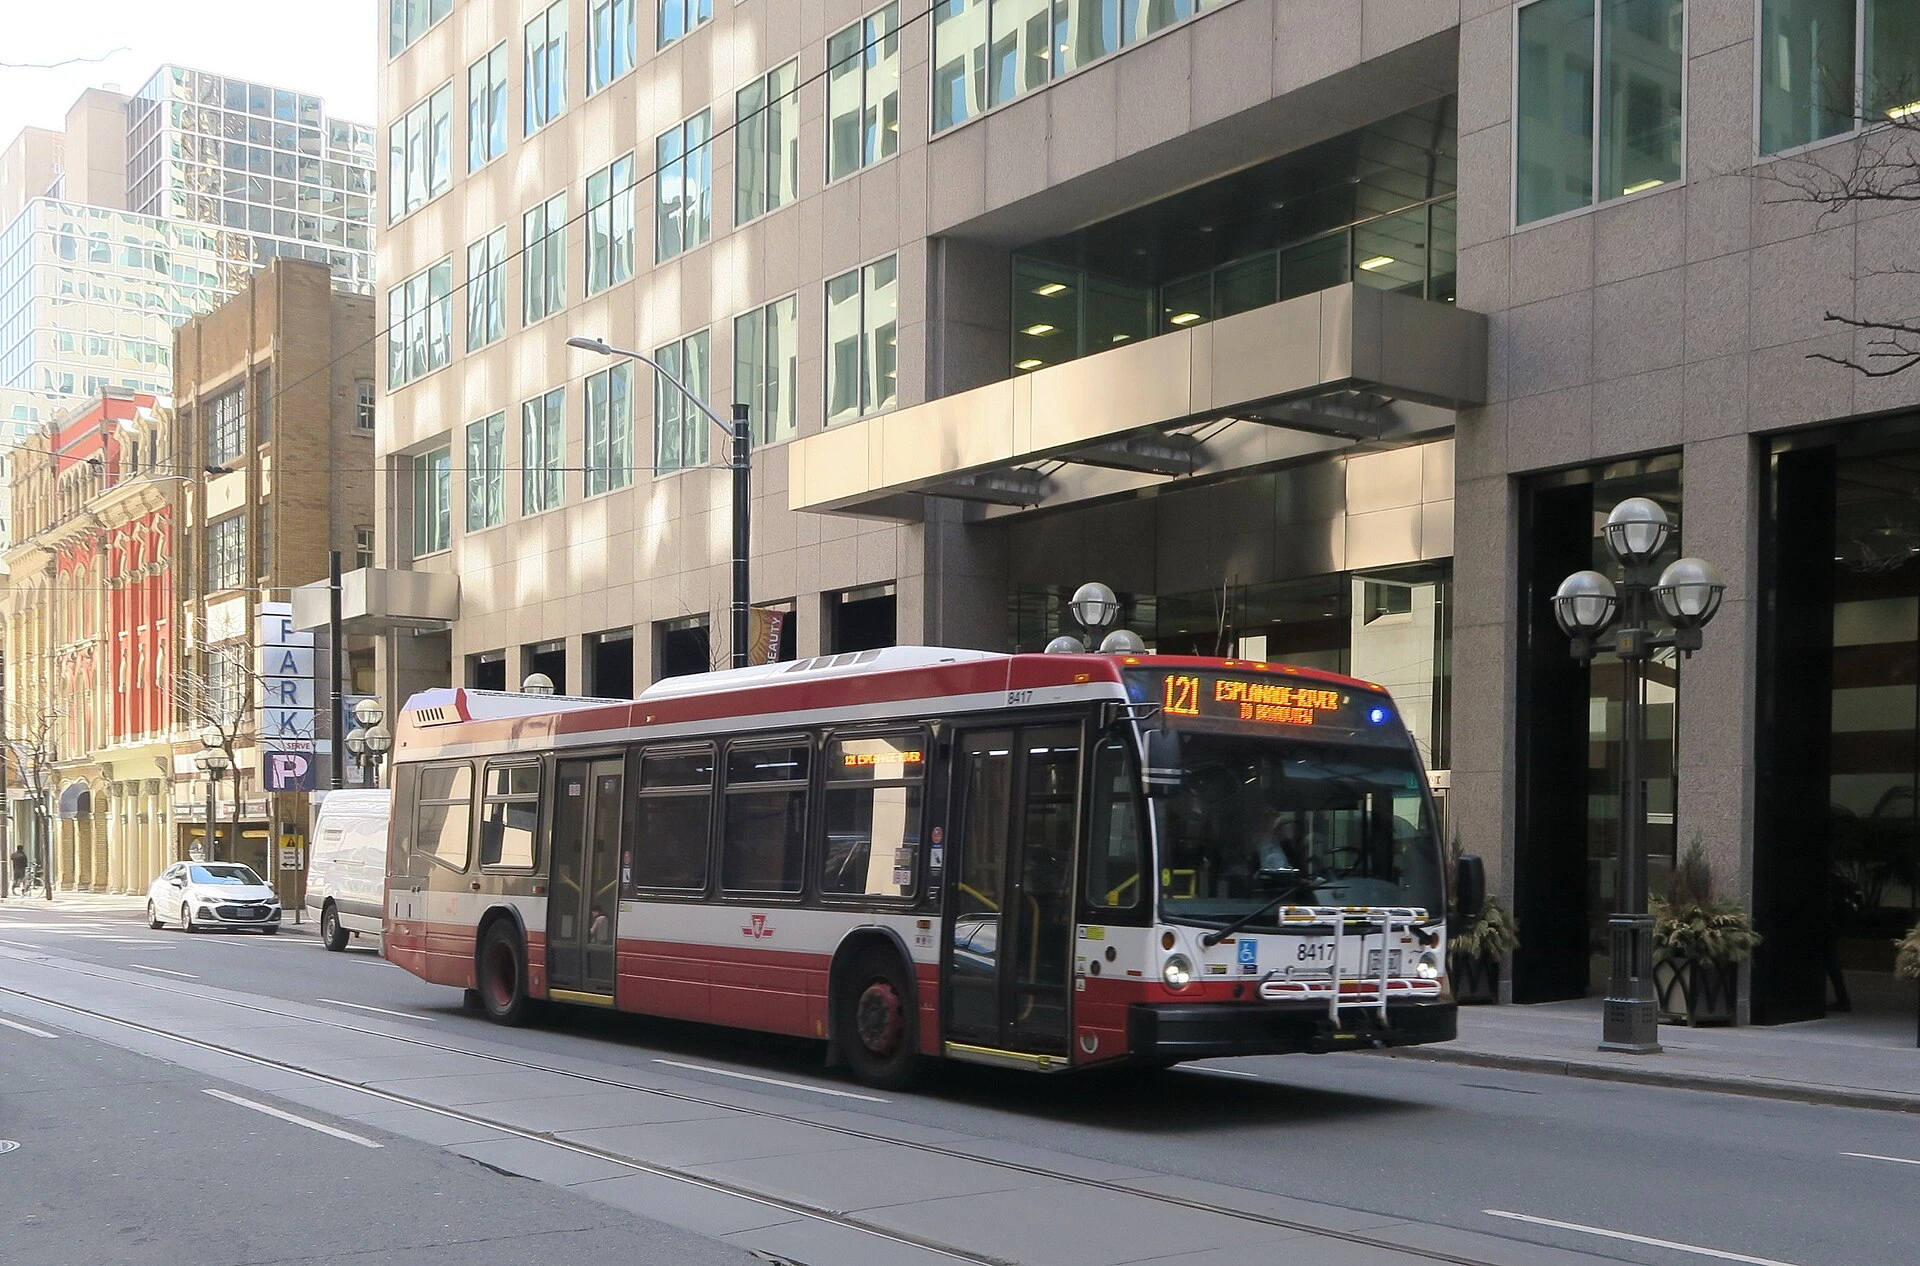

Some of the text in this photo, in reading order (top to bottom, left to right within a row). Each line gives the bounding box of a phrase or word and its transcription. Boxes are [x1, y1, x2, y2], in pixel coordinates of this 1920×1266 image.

[1008, 690, 1033, 704] 8417
[1163, 674, 1200, 715] 121
[286, 742, 310, 750] SERVE
[272, 754, 308, 789] P
[1297, 943, 1335, 961] 8417
